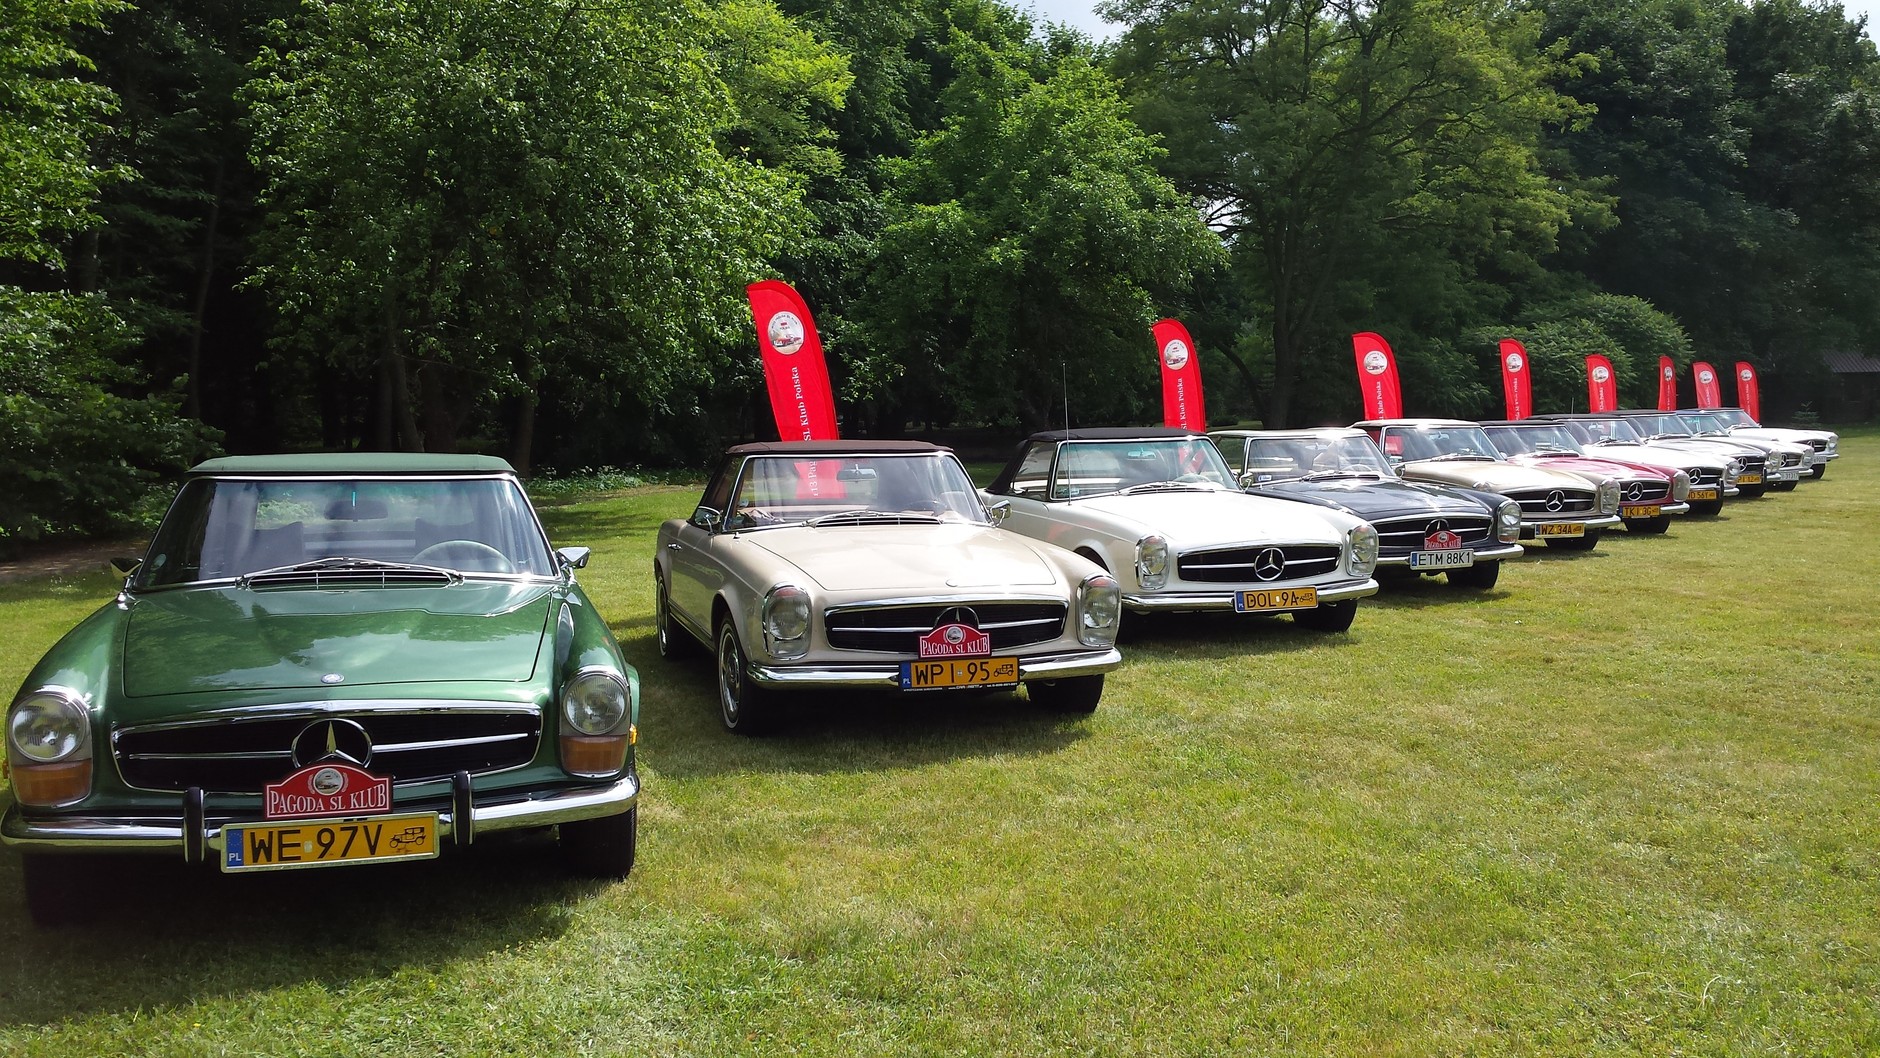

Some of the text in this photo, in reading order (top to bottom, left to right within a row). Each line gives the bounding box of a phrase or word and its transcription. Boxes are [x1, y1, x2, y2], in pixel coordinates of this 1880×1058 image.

[791, 366, 803, 400] Polska
[798, 401, 808, 425] Klub
[1542, 524, 1572, 535] WZ 34A
[1418, 552, 1470, 566] ETM 88K1
[1246, 592, 1298, 608] DOL 9A
[922, 636, 988, 655] PAGODA SL KLUB
[915, 662, 990, 685] WPI 95
[270, 782, 386, 814] PAGODA SL KLUB
[250, 824, 382, 864] WE 97V
[228, 852, 242, 862] PL
